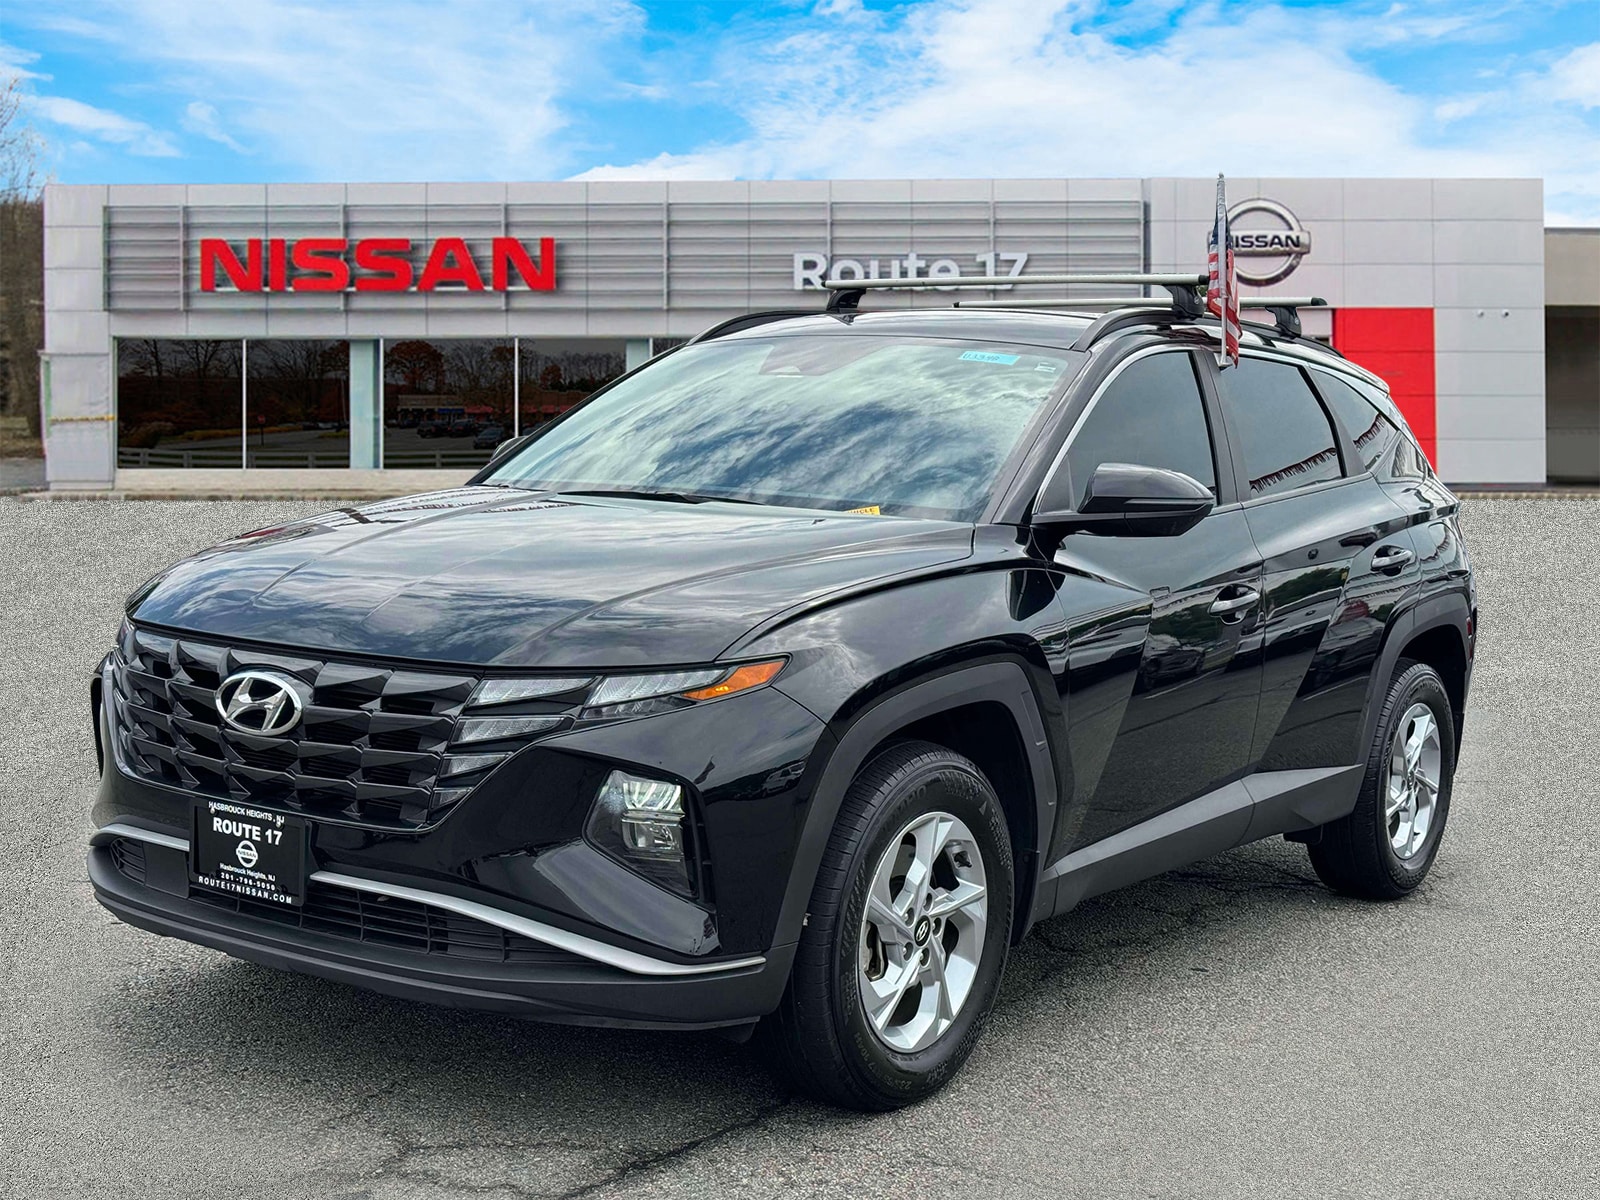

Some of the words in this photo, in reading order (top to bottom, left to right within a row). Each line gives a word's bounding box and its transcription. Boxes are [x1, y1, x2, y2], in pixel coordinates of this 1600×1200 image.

[1233, 234, 1300, 249] ISSAN
[200, 237, 556, 292] NISSAN
[793, 251, 961, 291] Route
[975, 251, 1028, 291] 17
[208, 801, 245, 815] HASBROUCK
[213, 817, 261, 841] ROUTE
[265, 829, 283, 845] 17
[198, 876, 292, 904] ROUTE17NISSAN.COM
[268, 874, 276, 882] NJ
